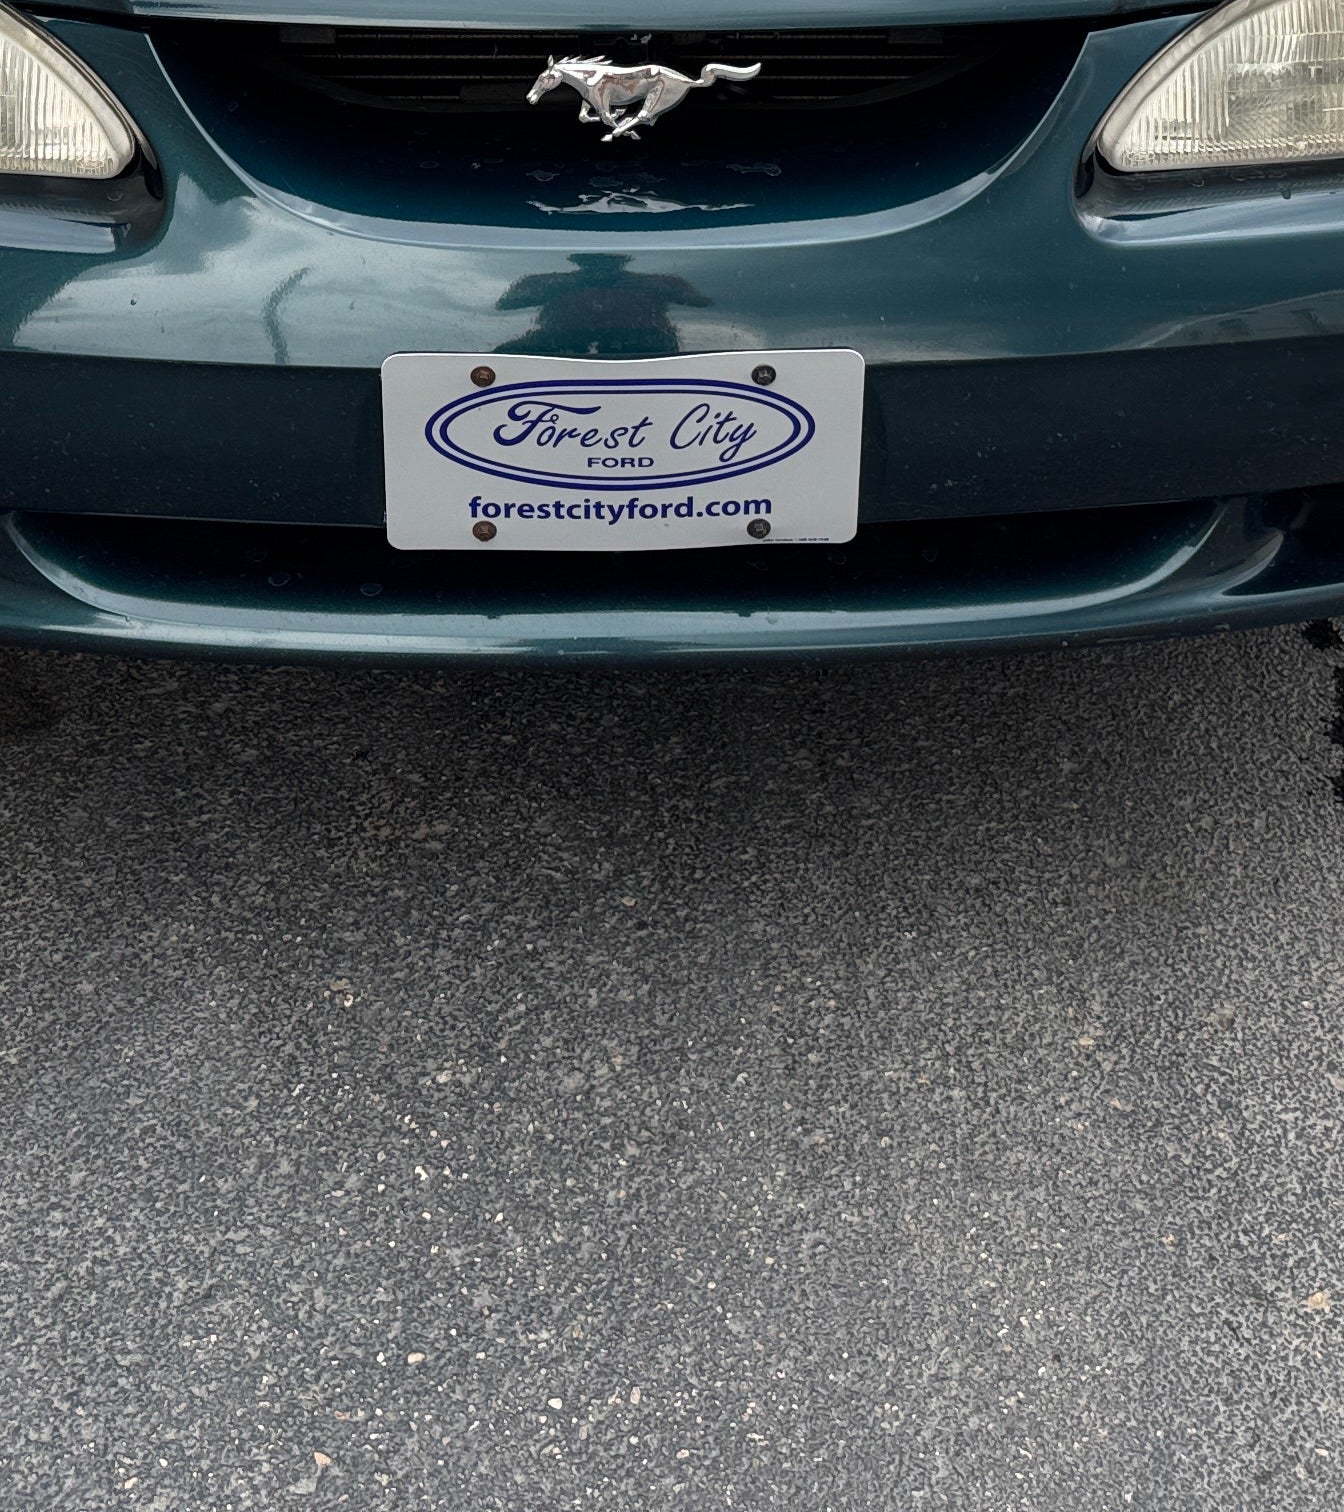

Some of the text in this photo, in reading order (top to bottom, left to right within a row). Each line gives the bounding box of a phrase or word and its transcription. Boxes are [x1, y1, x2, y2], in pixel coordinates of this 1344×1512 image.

[492, 400, 758, 463] Forest City
[586, 456, 655, 468] FORD
[468, 495, 773, 526] forestcityford.com
